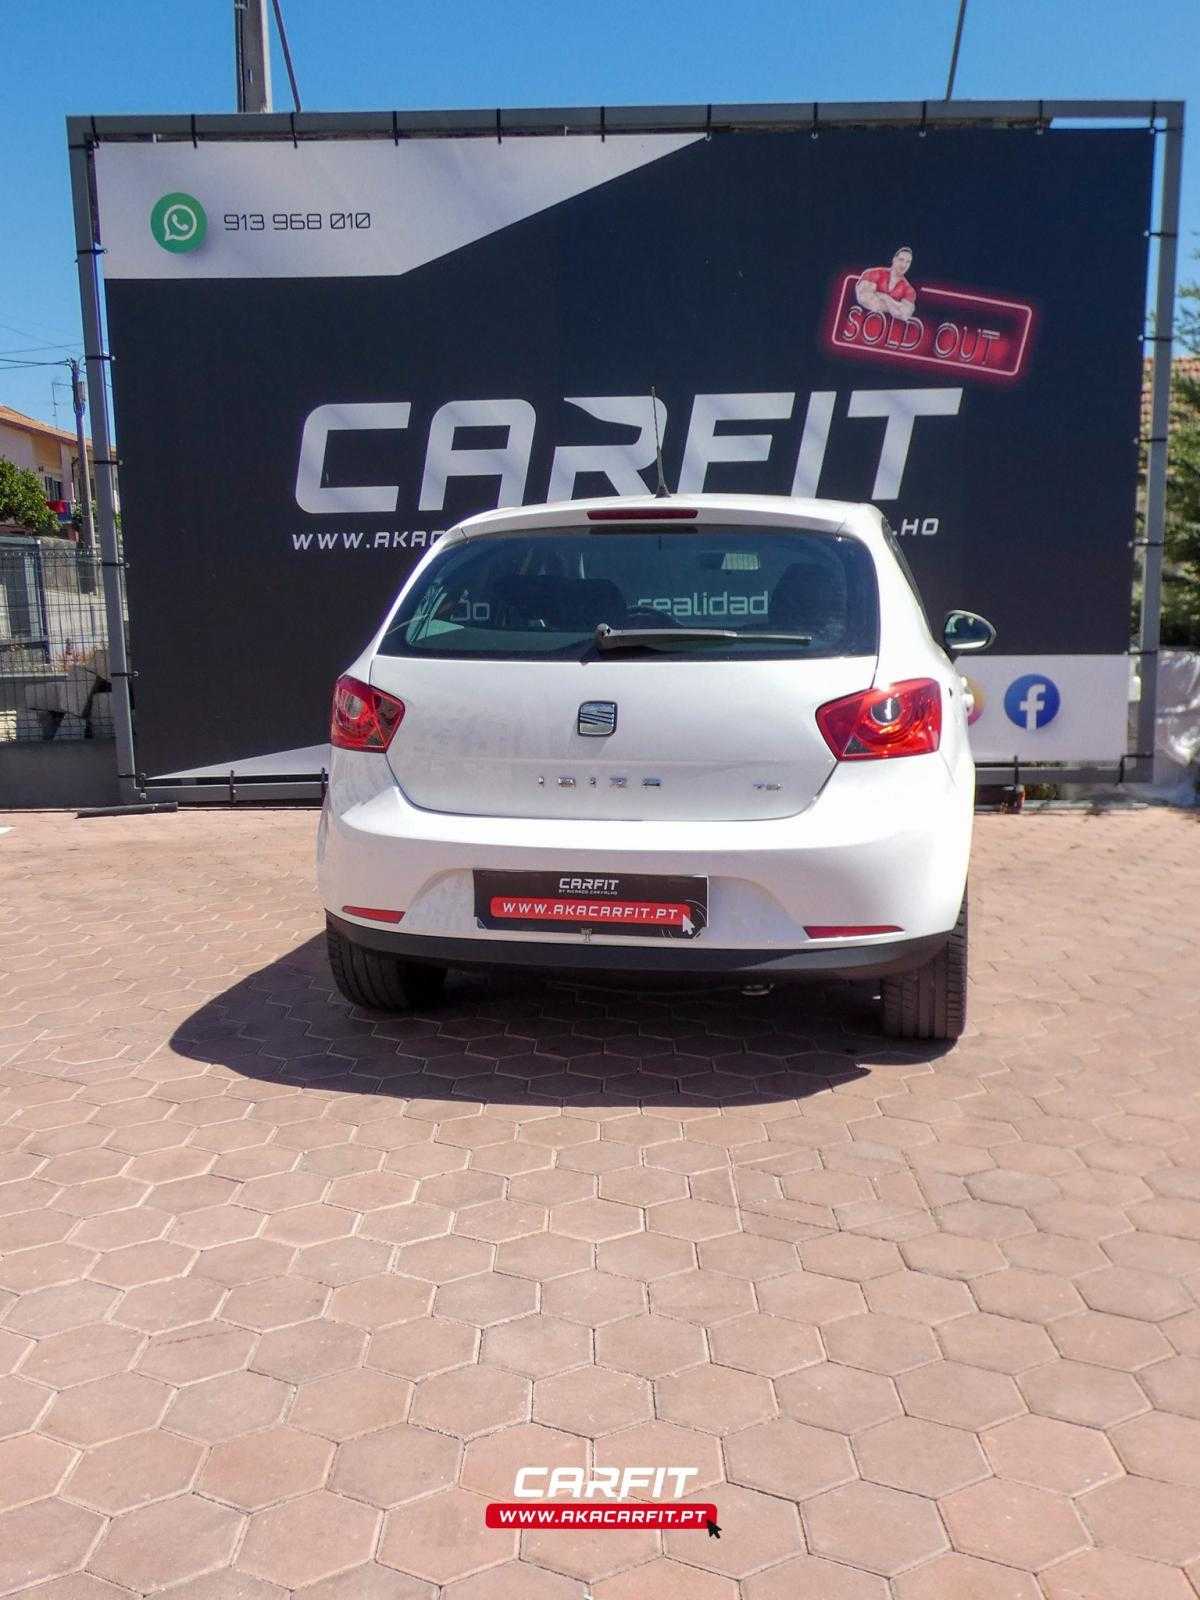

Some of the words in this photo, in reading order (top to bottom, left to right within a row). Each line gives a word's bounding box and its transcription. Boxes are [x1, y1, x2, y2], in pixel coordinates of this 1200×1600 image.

[224, 213, 265, 231] 913
[272, 213, 322, 230] 968
[329, 212, 371, 230] 010
[842, 305, 925, 351] SOLD
[934, 321, 1001, 365] OUT
[295, 387, 963, 514] CARFIT
[559, 877, 619, 891] CARFIT
[503, 902, 679, 921] WWW.AKACARFIT.PT
